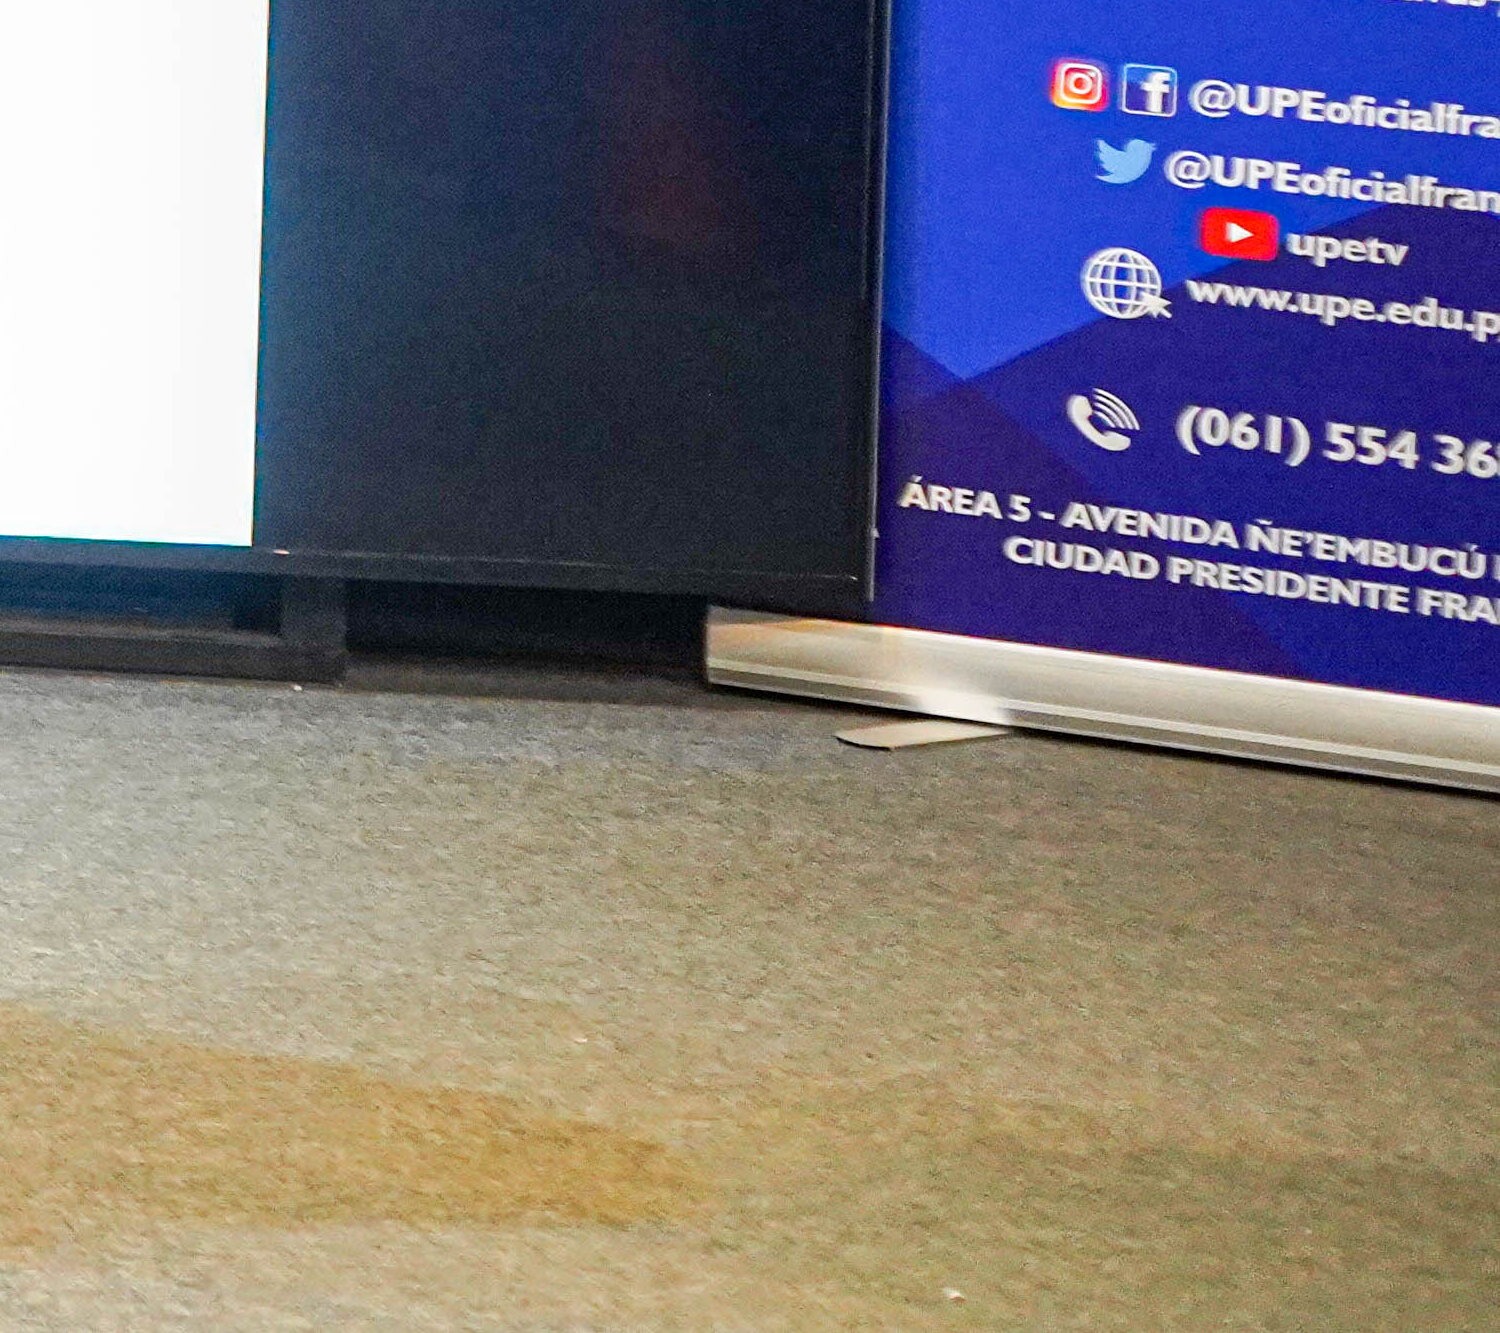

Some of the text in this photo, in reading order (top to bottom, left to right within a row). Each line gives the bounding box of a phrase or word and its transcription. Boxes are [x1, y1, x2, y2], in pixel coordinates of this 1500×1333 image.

[1285, 232, 1410, 268] upetv
[1184, 279, 1500, 344] www.upe.edu.p
[1174, 404, 1500, 480] (061) 554 36
[896, 473, 1004, 520] ÁREA
[1006, 493, 1032, 523] 5
[1059, 501, 1240, 550] AVENIDA
[1001, 534, 1500, 626] CIUDAD PRESIDENTE FRA
